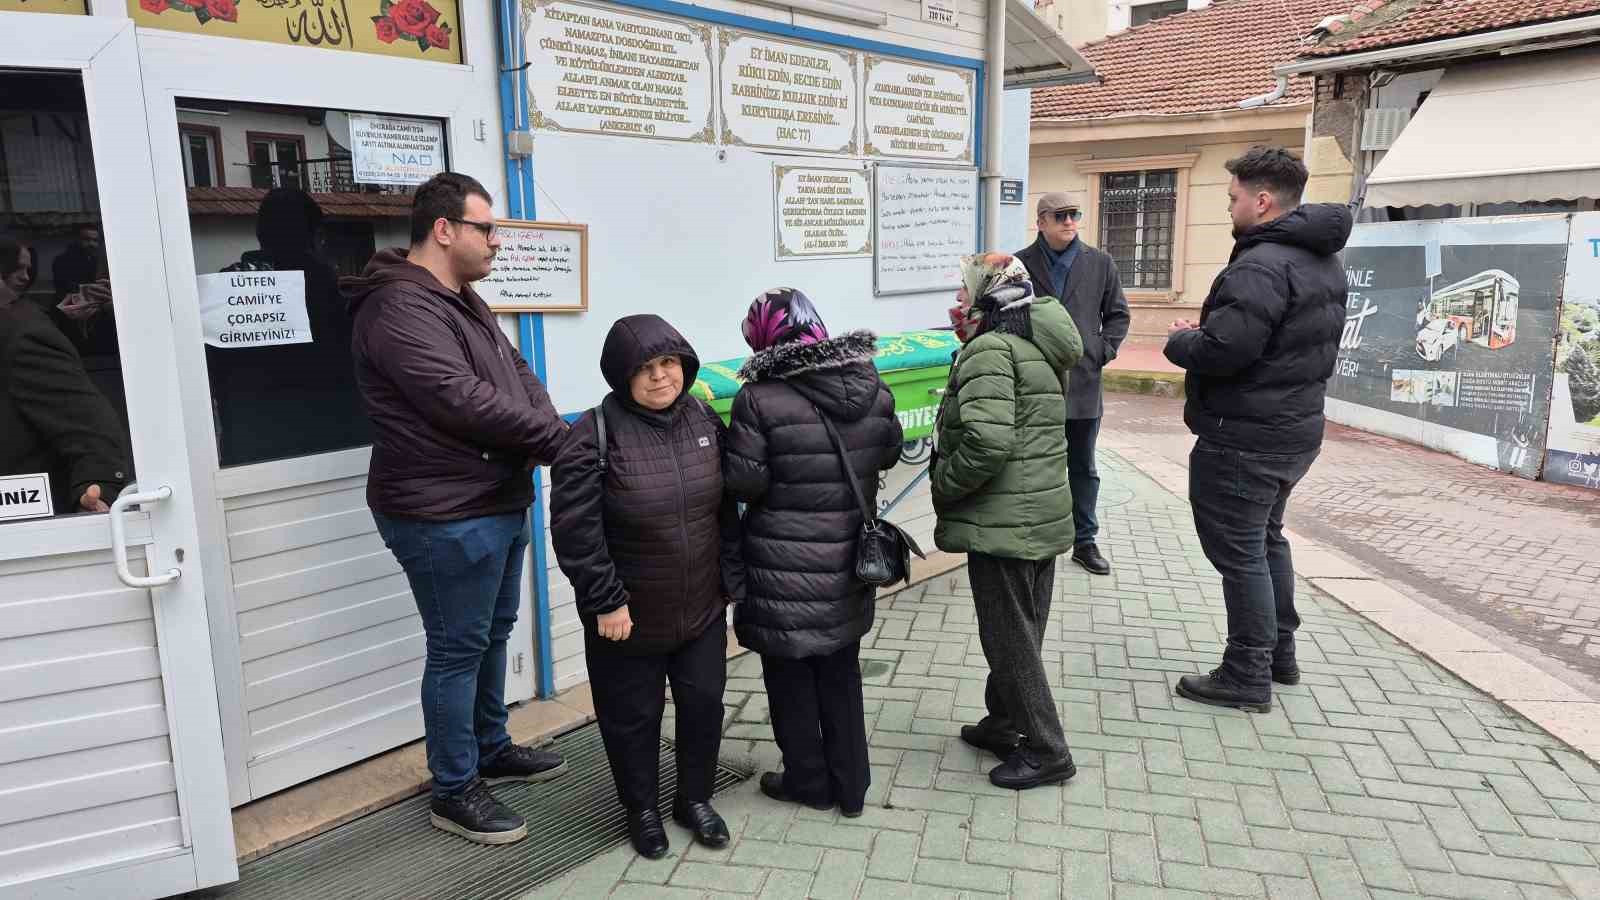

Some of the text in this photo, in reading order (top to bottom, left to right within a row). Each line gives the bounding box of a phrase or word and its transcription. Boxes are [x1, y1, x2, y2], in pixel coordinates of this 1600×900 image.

[544, 8, 590, 26] KİTAPTAN
[591, 17, 615, 31] SANA
[540, 38, 573, 52] ÇÜNKÜ
[609, 47, 639, 63] İNSANI
[615, 36, 661, 53] DOSDOĞRU
[554, 55, 568, 67] VE
[569, 58, 645, 77] KÖTÜLÜKLERDEN
[751, 47, 832, 72] EY İMAN EDENLER,
[768, 67, 791, 85] EDİN,
[793, 72, 820, 88] SECDE
[821, 76, 842, 91] EDİN
[599, 77, 630, 91] ANMAK
[632, 82, 654, 94] OLAN
[655, 84, 683, 97] NAMAZ
[556, 86, 598, 101] ELBETTE
[599, 90, 612, 102] EN
[613, 92, 642, 106] BÜYÜK
[782, 89, 817, 105] KULLUK
[818, 93, 839, 108] EDİN
[840, 95, 849, 109] Kİ
[555, 101, 586, 114] ALLAH
[869, 95, 881, 106] VEYA
[914, 101, 930, 112] KÜÇÜK
[931, 103, 939, 113] BİR
[741, 103, 796, 123] KURTULUŞA
[776, 126, 812, 143] (HAC 77)
[378, 141, 396, 150] ALTINA
[908, 140, 917, 150] BİR
[392, 152, 433, 167] NAD
[798, 174, 806, 183] EY
[807, 173, 822, 183] İMAN
[798, 185, 815, 194] TAKVA
[817, 185, 836, 195] SAHİBİ
[785, 196, 805, 205] ALLAH
[819, 197, 834, 206] NASIL
[784, 218, 793, 227] VE
[804, 218, 823, 227] ANCAK
[804, 229, 827, 238] OLARAK
[231, 275, 276, 288] LÜTFEN
[227, 293, 283, 306] CAMİİ'YE
[227, 312, 286, 327] ÇORAPSIZ
[220, 329, 296, 343] GİRMEYİNİZ!
